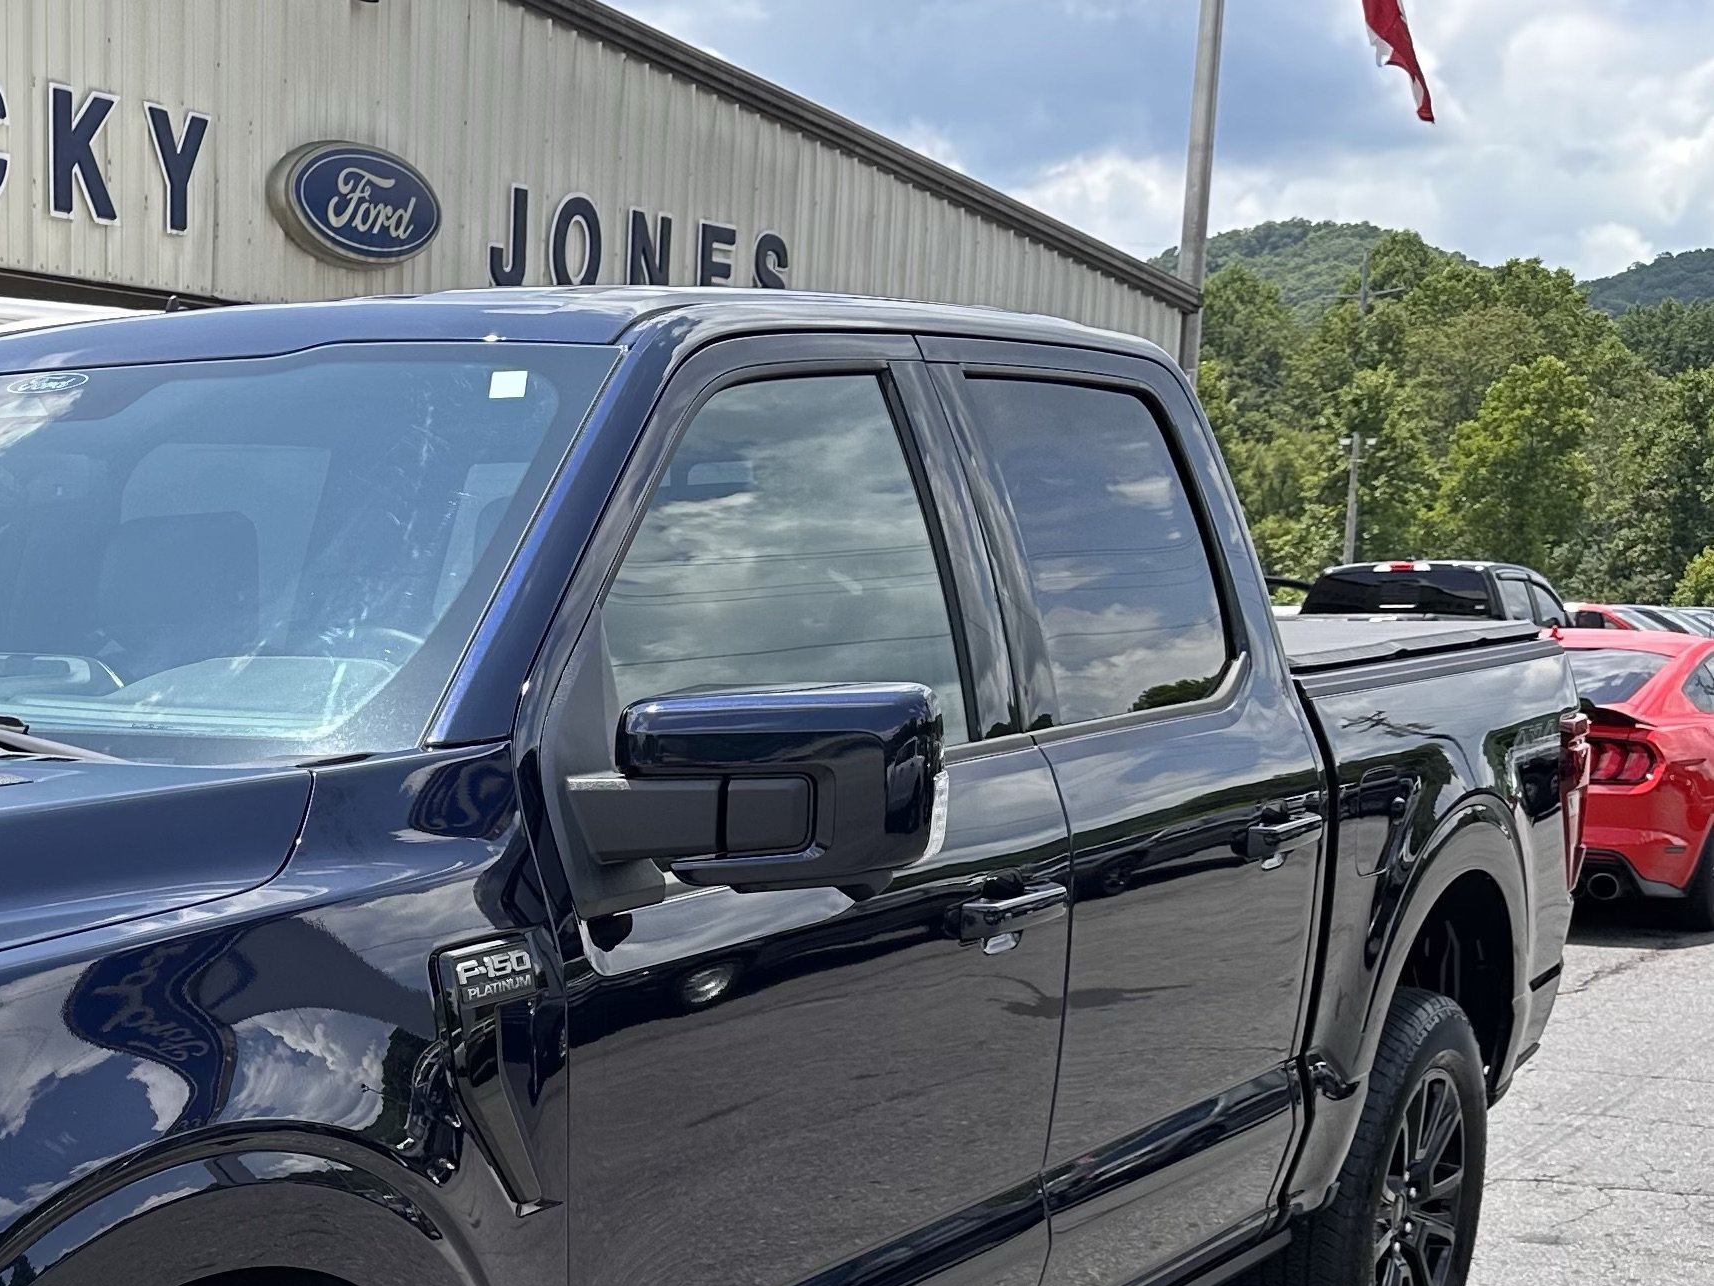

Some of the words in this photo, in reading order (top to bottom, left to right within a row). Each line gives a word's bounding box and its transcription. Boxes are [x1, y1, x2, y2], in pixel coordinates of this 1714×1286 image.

[326, 166, 417, 241] Ford
[488, 183, 789, 288] JONES
[456, 949, 532, 985] F-150
[467, 974, 532, 1001] PLATINUM
